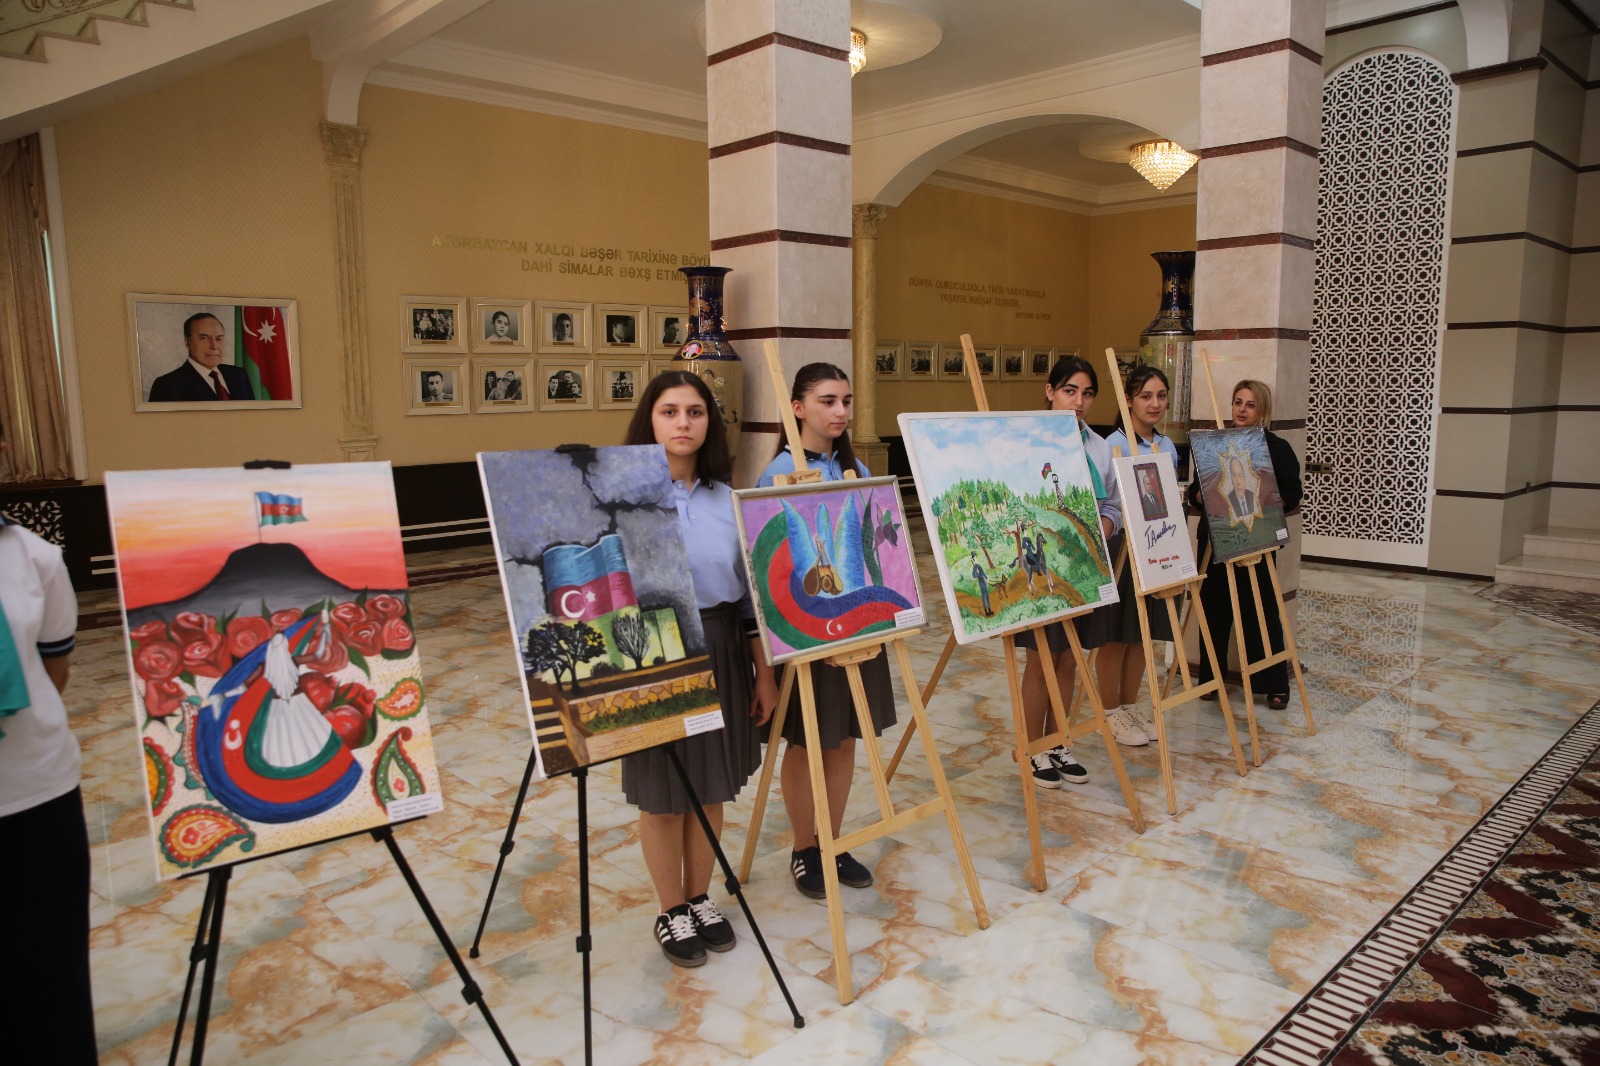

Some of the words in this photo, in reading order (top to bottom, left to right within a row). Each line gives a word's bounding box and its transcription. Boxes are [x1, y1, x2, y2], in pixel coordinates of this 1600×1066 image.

[534, 243, 574, 258] XALQI
[580, 247, 623, 262] BƏŞƏR
[627, 249, 677, 265] TARİXİNƏ
[682, 253, 710, 267] BÖYÜ
[521, 258, 552, 273] DAHİ
[558, 260, 614, 277] SİMALAR
[620, 267, 651, 282] BƏXŞ
[909, 275, 933, 288] DÜNYA
